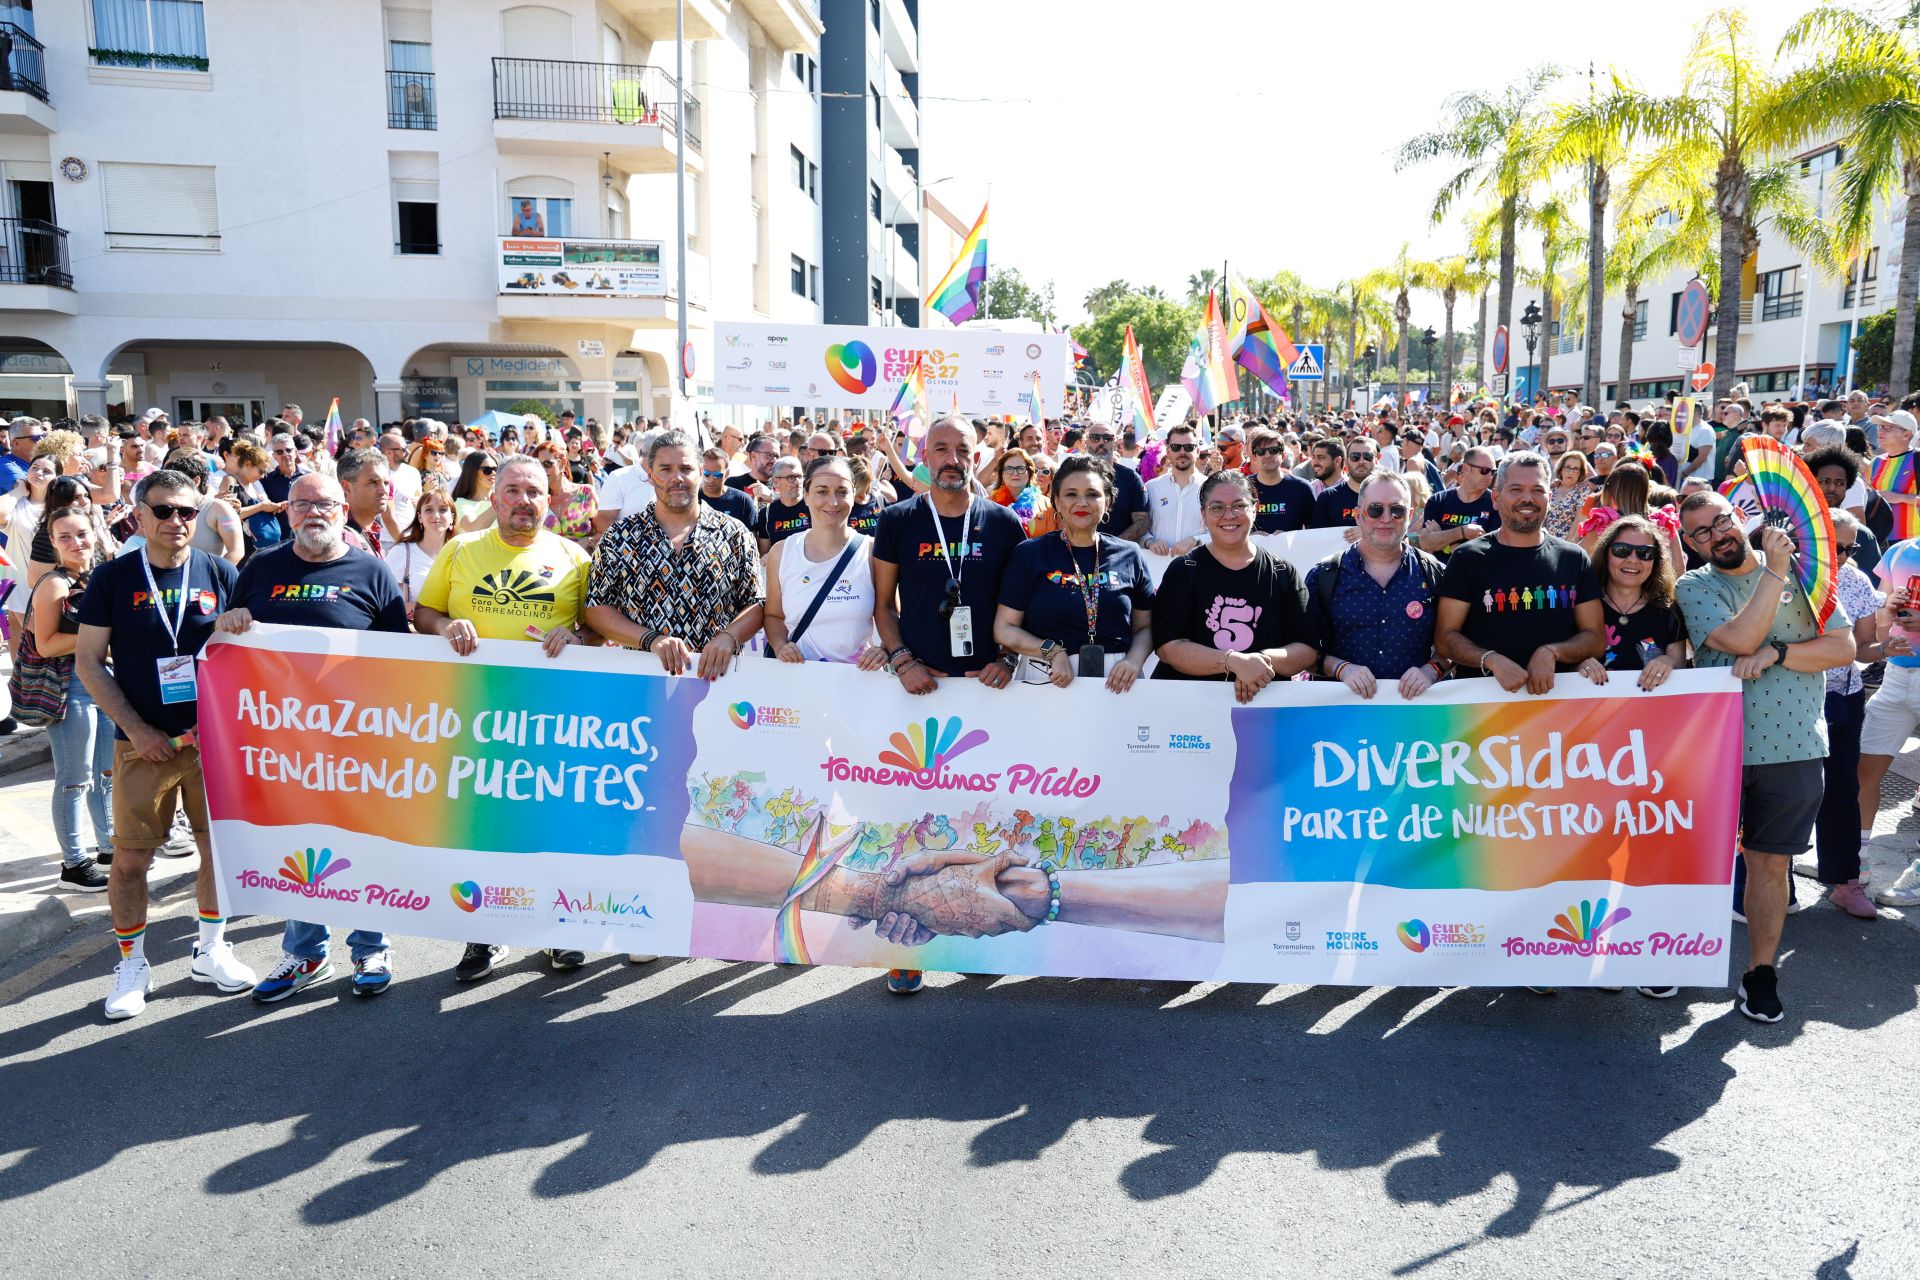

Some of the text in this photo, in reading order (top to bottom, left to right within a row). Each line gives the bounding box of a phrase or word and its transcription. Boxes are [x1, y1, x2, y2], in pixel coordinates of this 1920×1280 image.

[490, 358, 561, 371] Medident
[939, 365, 959, 378] 27
[1256, 503, 1286, 512] RIDE
[774, 518, 808, 530] PRIDE
[851, 518, 878, 528] PRID
[1442, 513, 1478, 524] PRIDE
[918, 542, 982, 556] PRIDE
[270, 584, 340, 598] PRIDE
[472, 598, 492, 606] Coro
[472, 605, 552, 620] TORREMOLINOS
[1170, 734, 1202, 742] TORRE
[1168, 742, 1210, 750] MOLINOS
[1006, 764, 1101, 798] Pride
[1614, 800, 1693, 837] ADN
[365, 884, 430, 911] Pride
[521, 898, 535, 906] 27
[552, 888, 654, 919] Andalucía
[1326, 932, 1366, 940] TORRE
[1471, 934, 1486, 943] 27
[1326, 941, 1378, 950] MOLINOS
[1649, 932, 1722, 956] Pride
